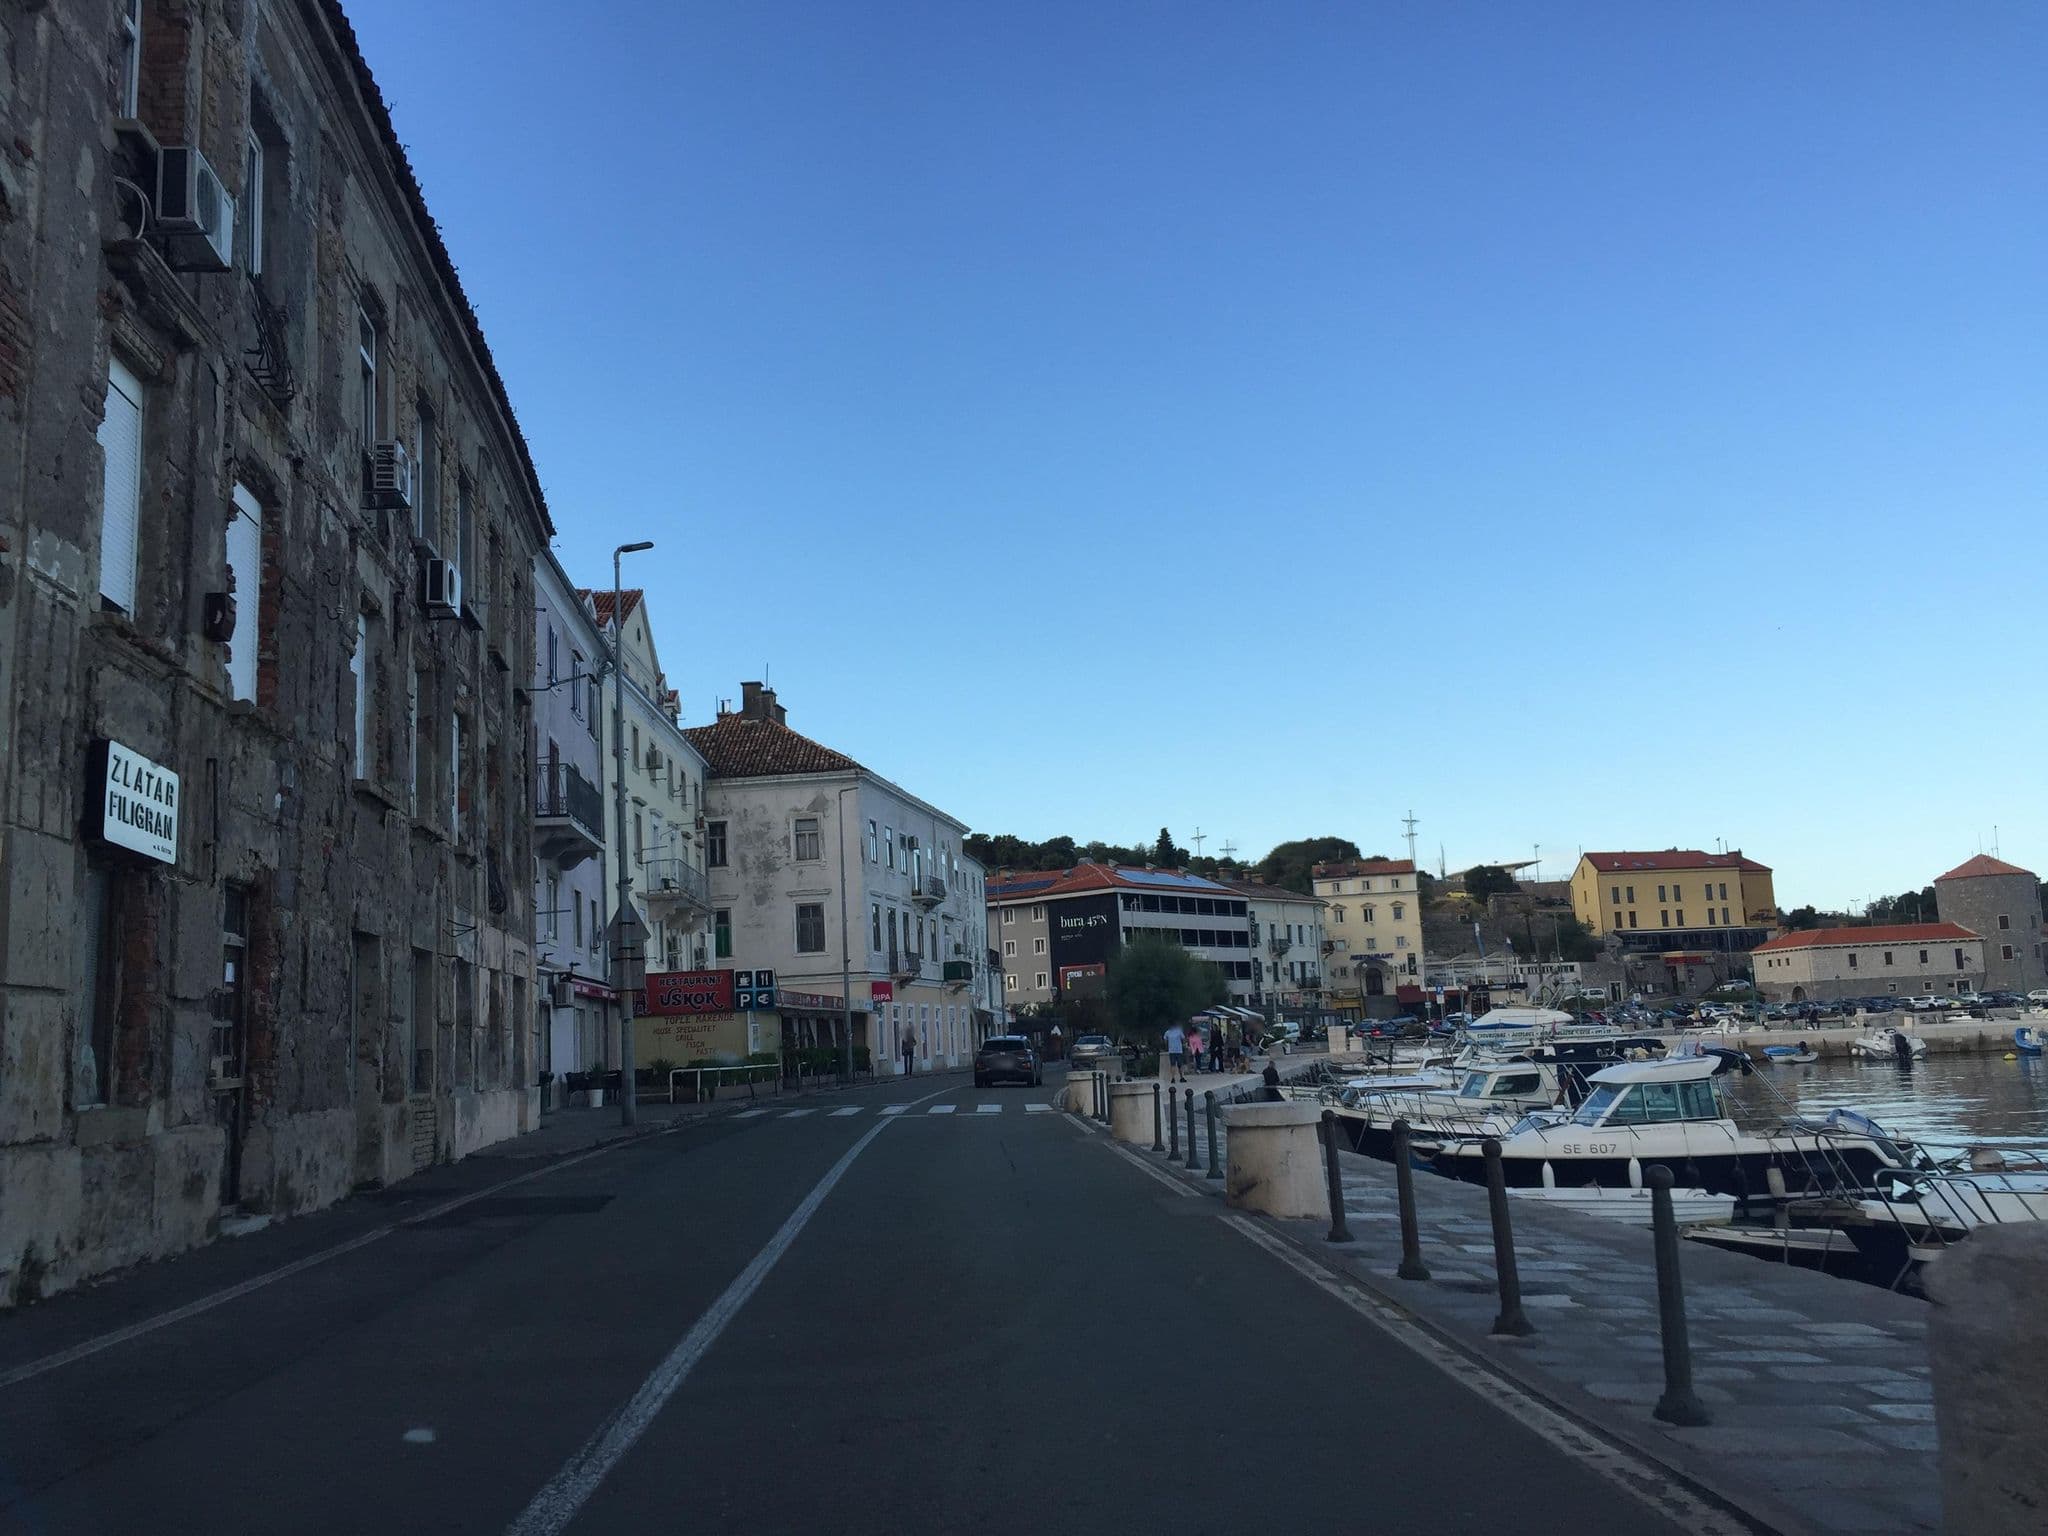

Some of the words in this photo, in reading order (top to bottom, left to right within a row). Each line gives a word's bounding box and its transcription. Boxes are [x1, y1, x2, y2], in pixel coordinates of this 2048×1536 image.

[111, 754, 174, 808] ZLATAR
[109, 790, 173, 841] FILIGRAN
[1060, 915, 1086, 928] bura
[659, 976, 722, 988] RESTAURANT
[660, 988, 724, 1010] USKOK
[873, 993, 891, 1001] BIPA
[664, 1015, 691, 1026] TOPLE
[1563, 1144, 1582, 1154] SE
[1589, 1143, 1617, 1154] 607
